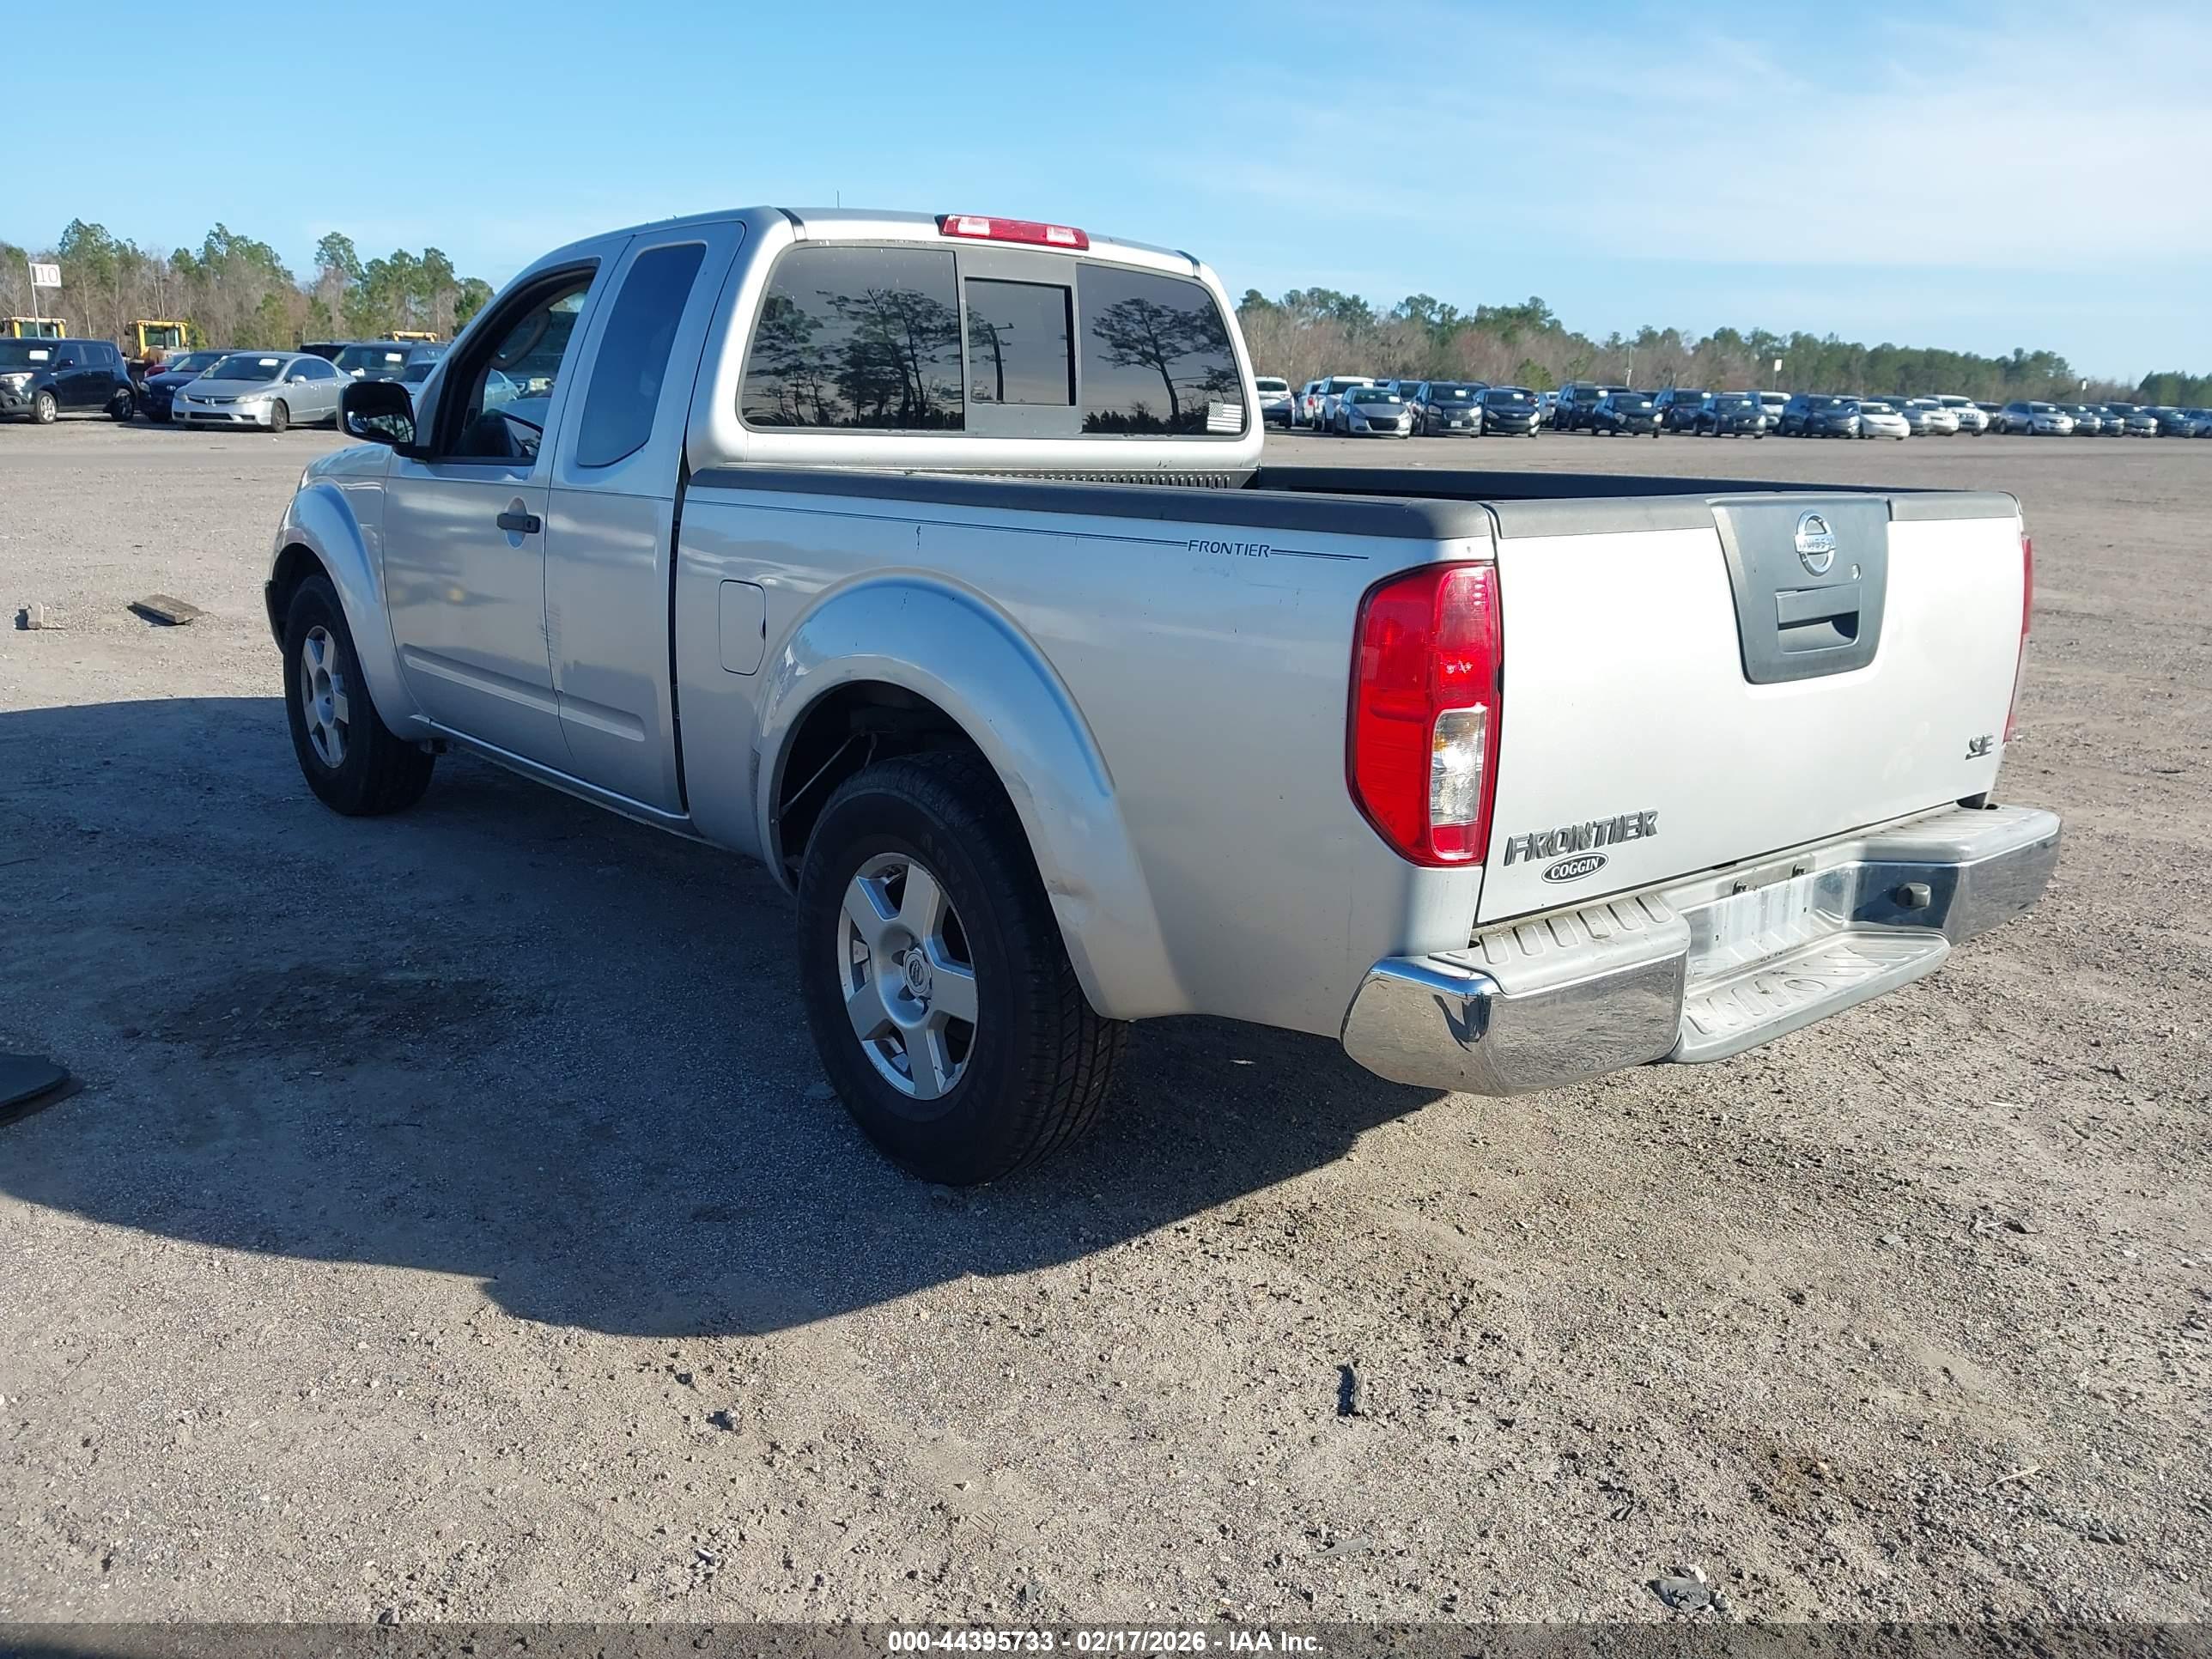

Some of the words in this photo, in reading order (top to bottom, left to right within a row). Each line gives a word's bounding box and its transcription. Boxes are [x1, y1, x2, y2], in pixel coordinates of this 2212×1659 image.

[38, 267, 58, 283] 10
[1188, 539, 1270, 557] FRONTIER
[1965, 734, 1994, 761] SE
[1504, 809, 1659, 866] FRONTIER
[1551, 857, 1599, 879] COGGIN
